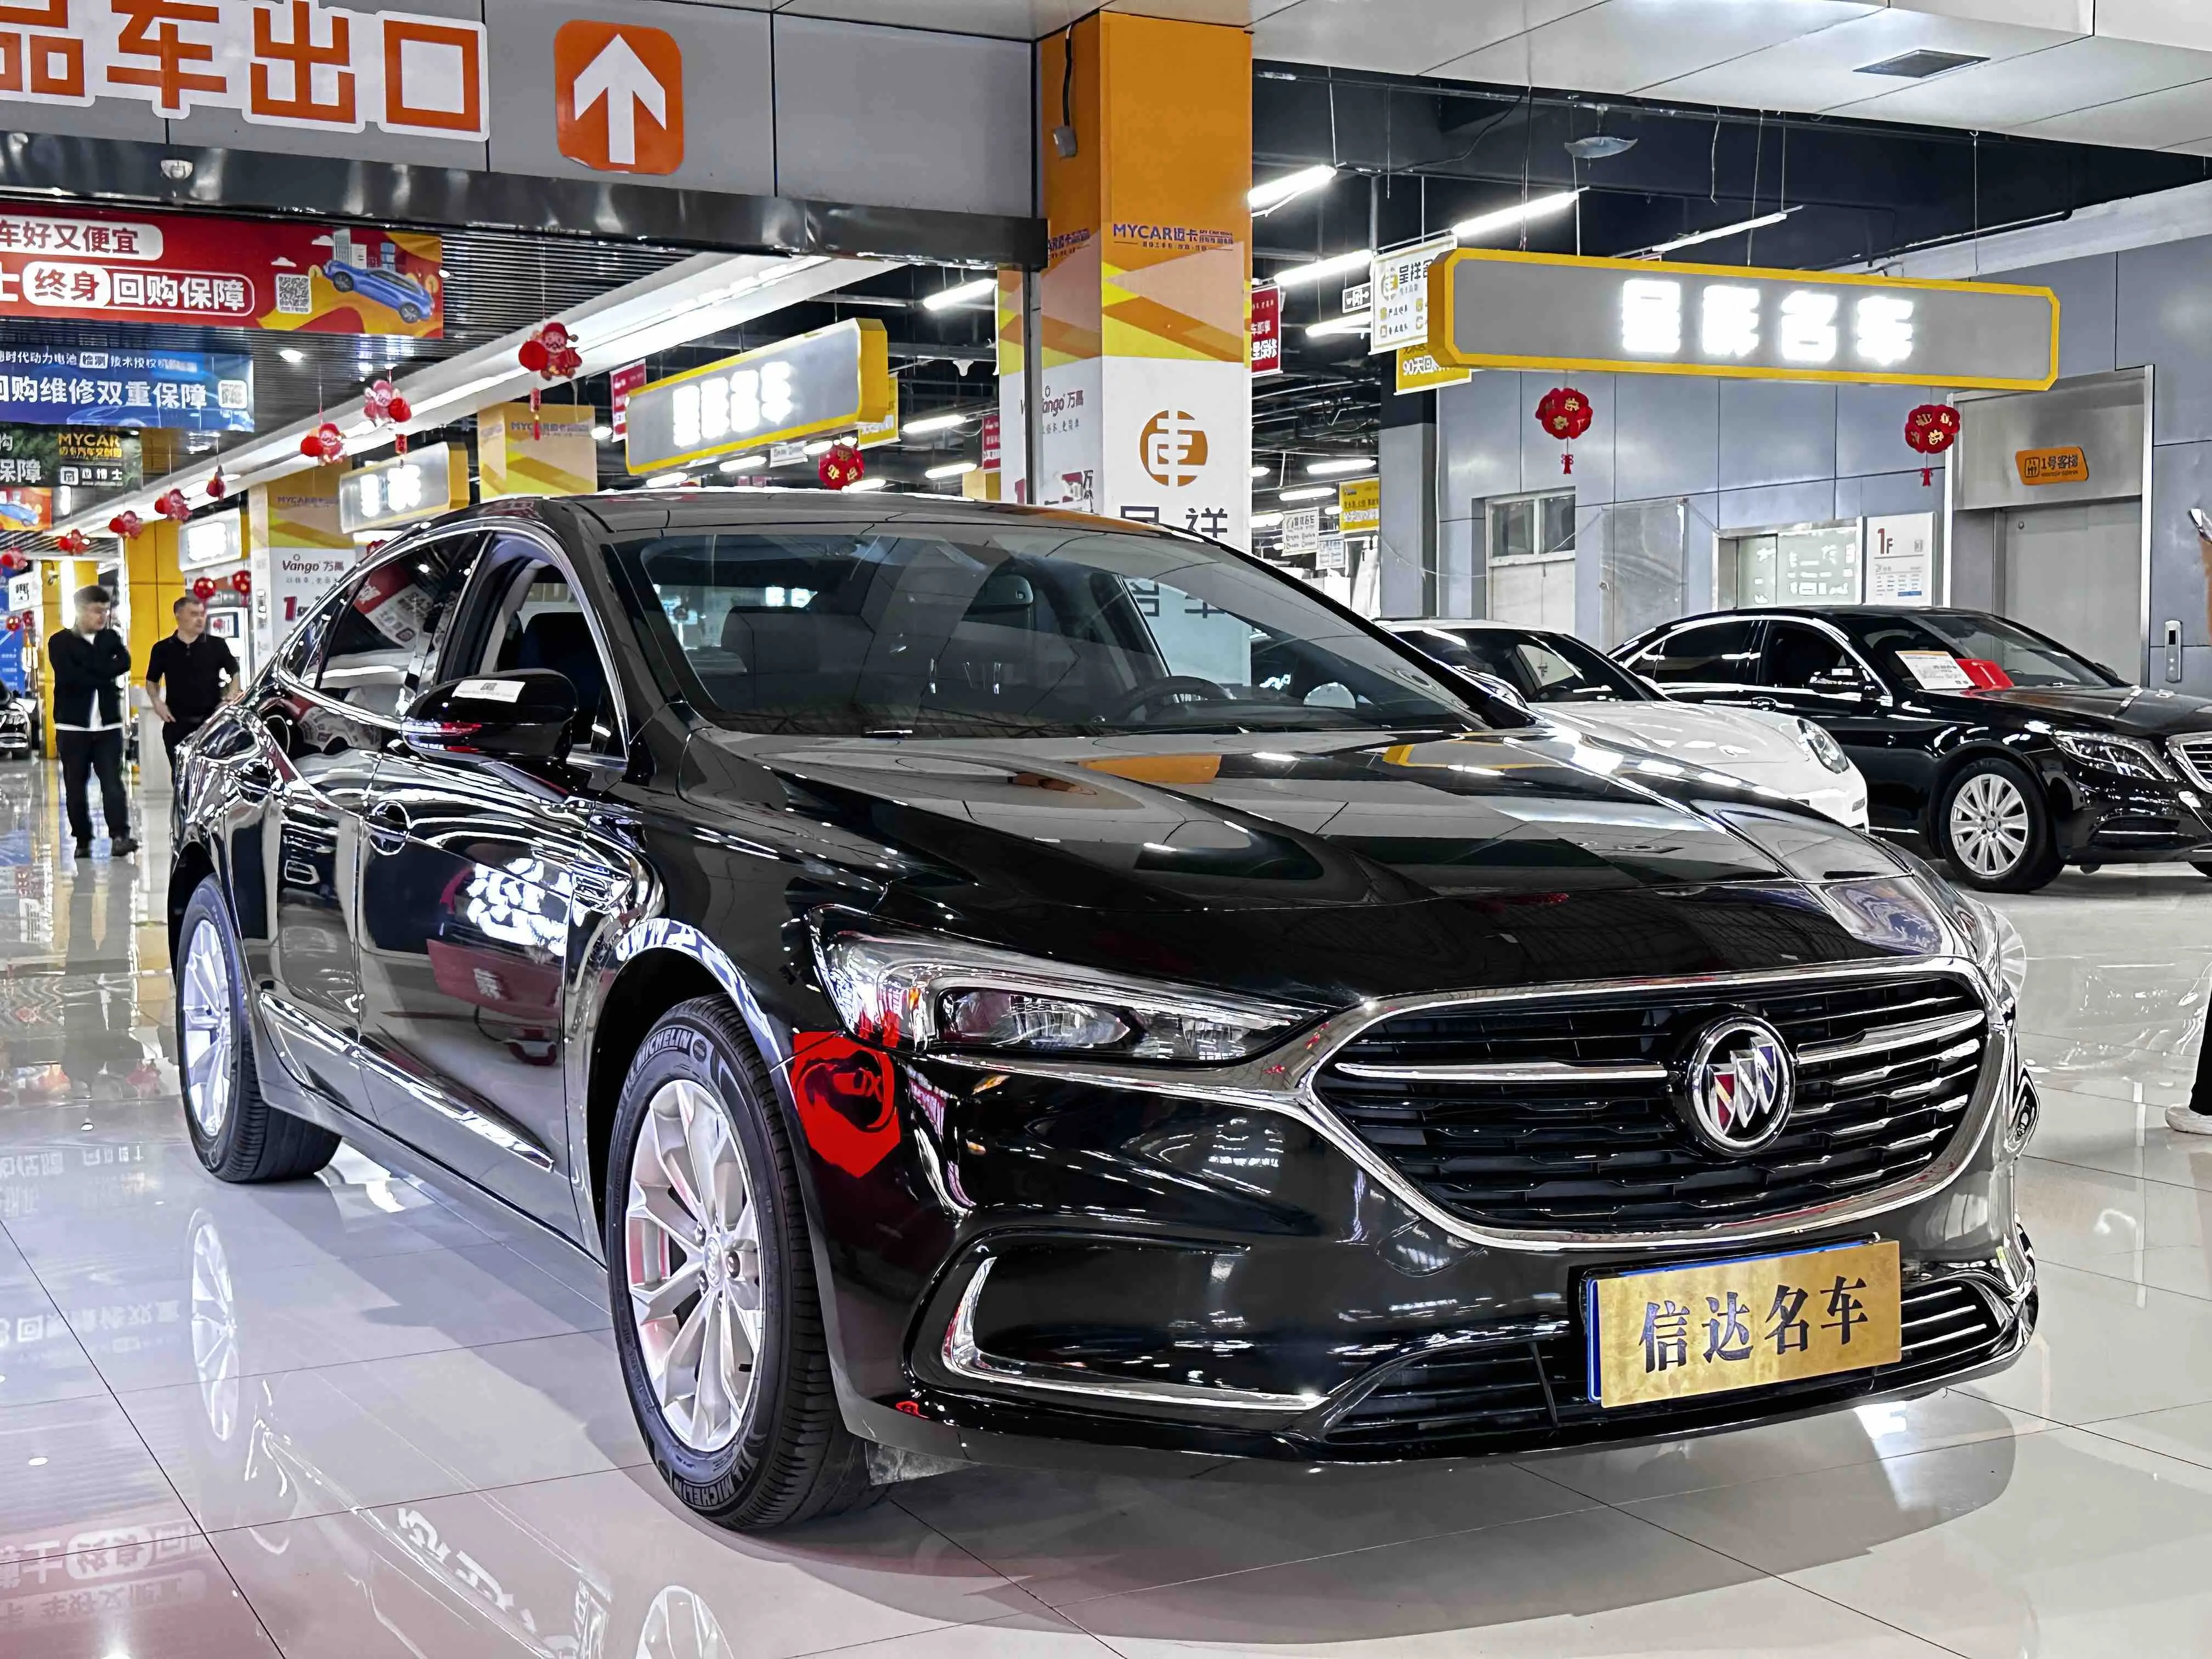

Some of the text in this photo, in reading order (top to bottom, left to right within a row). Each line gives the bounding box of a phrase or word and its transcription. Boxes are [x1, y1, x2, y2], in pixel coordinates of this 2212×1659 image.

[35, 267, 100, 302] 终身
[114, 273, 246, 311] 回购保障
[0, 350, 77, 365] 时代动力电池
[1877, 528, 1893, 554] 1F
[282, 560, 319, 574] Vango
[636, 1029, 693, 1071] MICHELIN
[1639, 1276, 1869, 1373] 信达名车
[674, 1474, 735, 1506] MICHELIN
